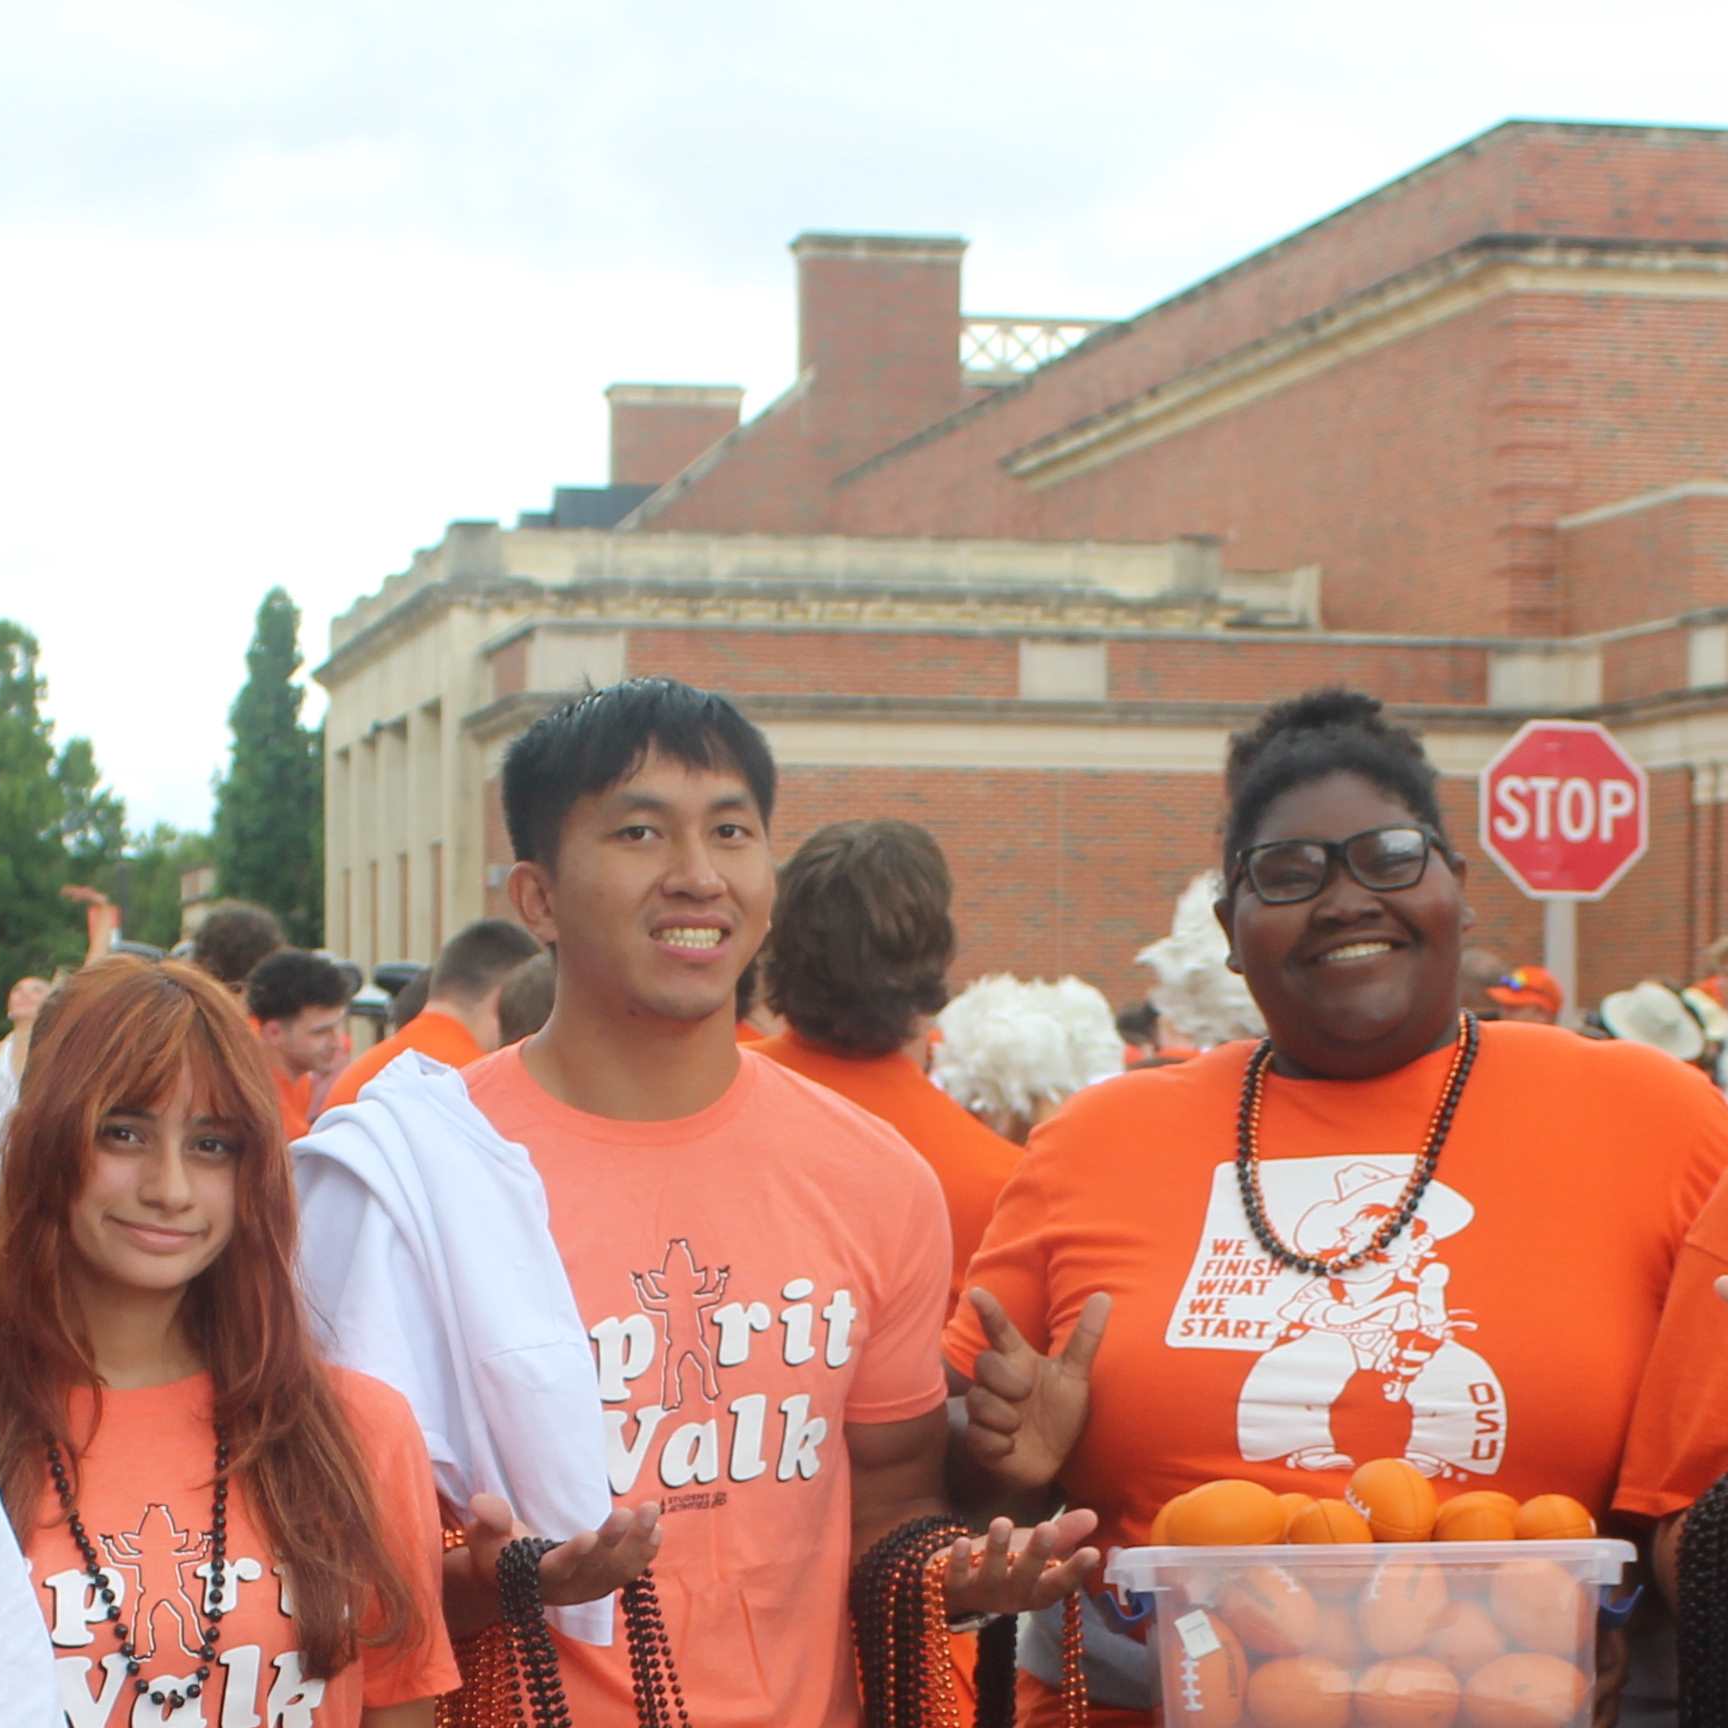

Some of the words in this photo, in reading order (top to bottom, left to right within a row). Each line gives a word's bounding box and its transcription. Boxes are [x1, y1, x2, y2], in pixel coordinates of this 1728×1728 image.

[1493, 776, 1635, 842] STOP
[1212, 1238, 1248, 1255] WE
[1201, 1258, 1284, 1277] FINISH
[1196, 1279, 1271, 1295] WHAT
[1188, 1297, 1229, 1314] WE
[1179, 1318, 1271, 1338] START
[1468, 1382, 1498, 1460] OSU
